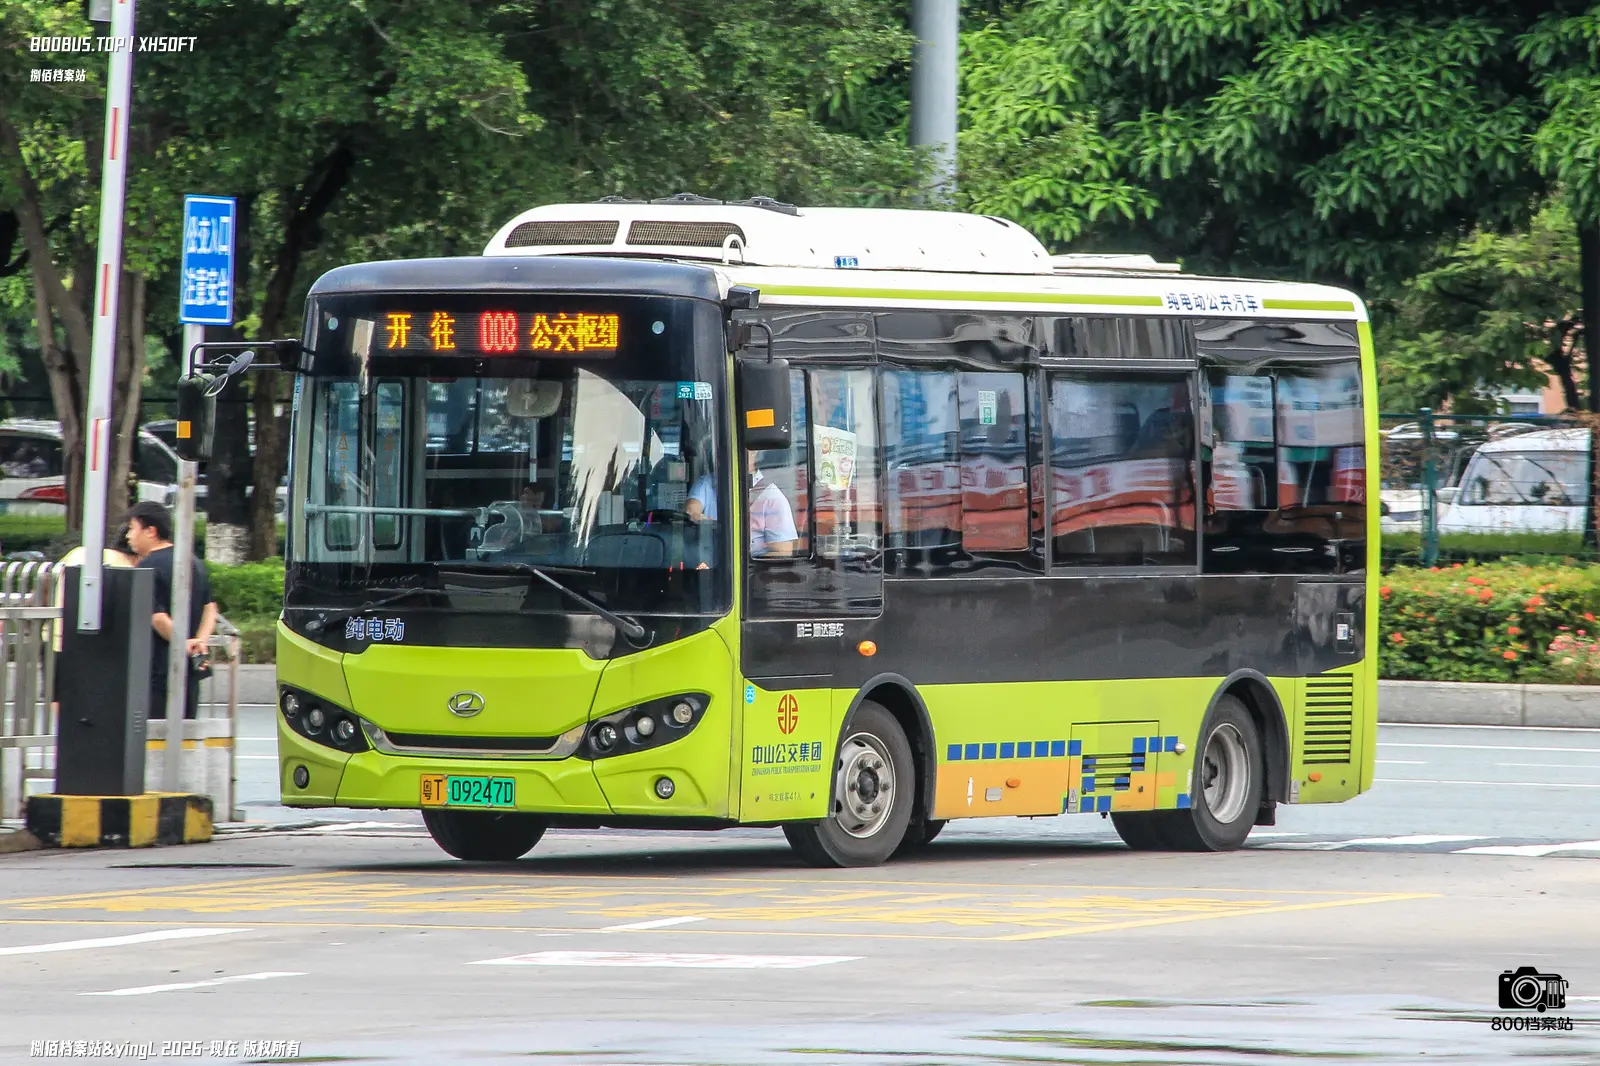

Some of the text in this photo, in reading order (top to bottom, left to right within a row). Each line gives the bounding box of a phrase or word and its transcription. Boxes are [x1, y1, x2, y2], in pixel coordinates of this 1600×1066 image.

[1165, 293, 1258, 312] 纯电动公共汽车
[482, 313, 518, 351] 008
[530, 312, 619, 351] 公交枢纽
[345, 616, 405, 641] 纯电动
[752, 741, 822, 764] 中山公交集团
[452, 780, 513, 803] 09247D
